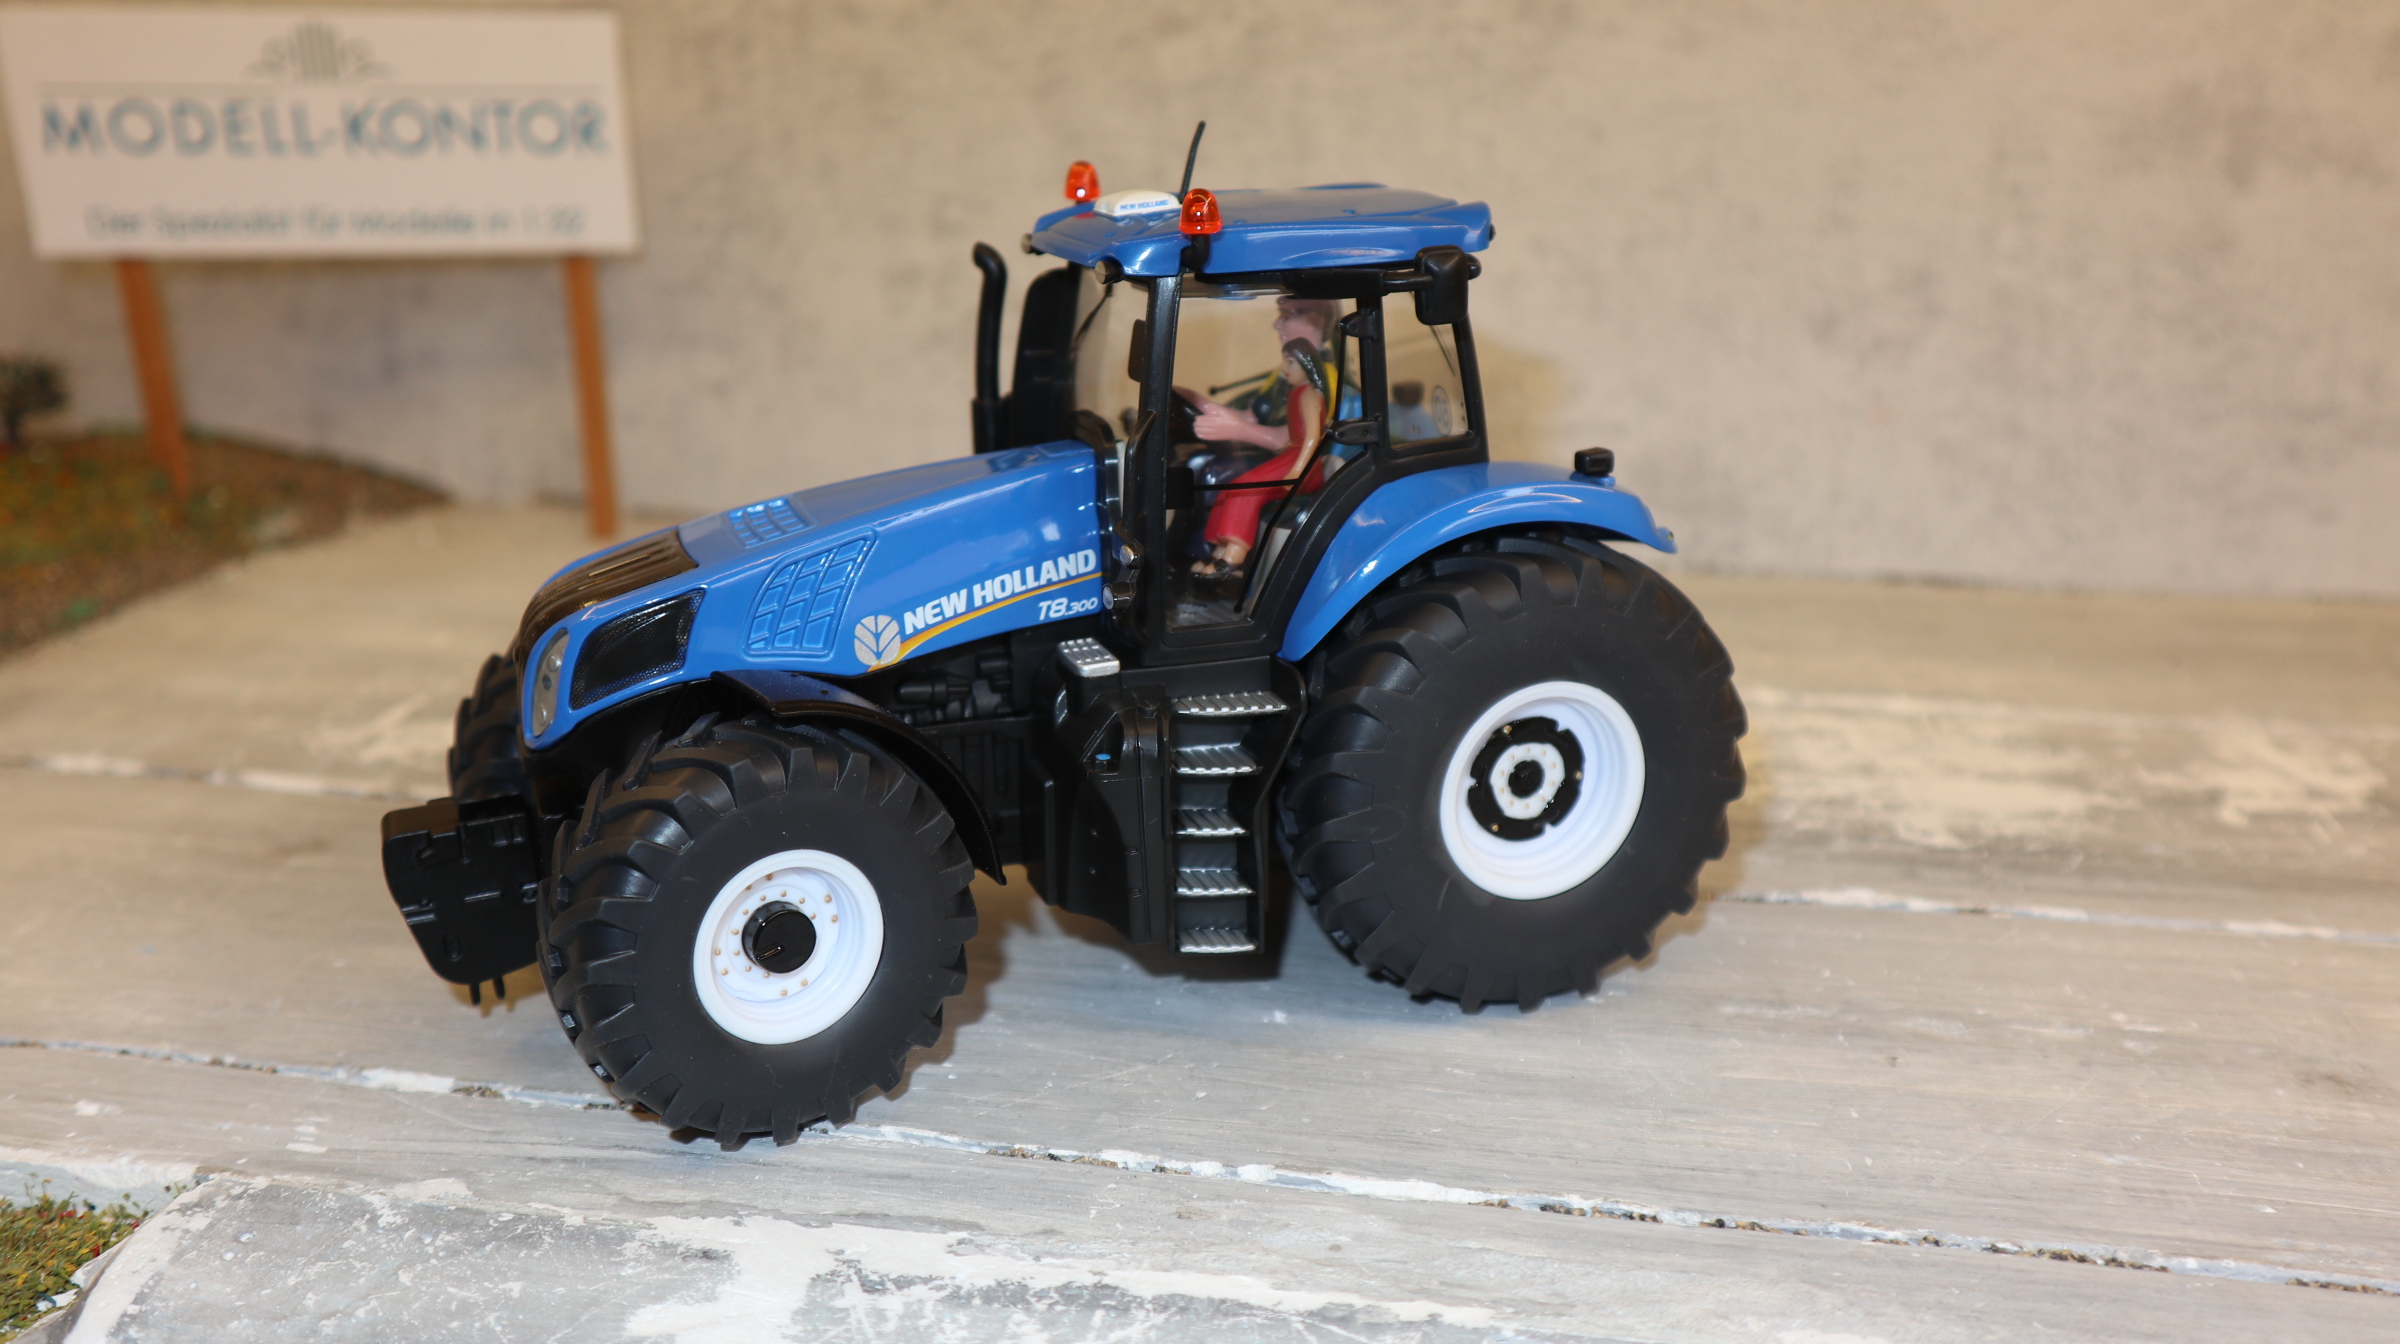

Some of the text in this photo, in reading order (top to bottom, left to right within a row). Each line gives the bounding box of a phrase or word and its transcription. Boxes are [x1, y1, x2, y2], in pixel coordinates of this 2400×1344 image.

[41, 95, 611, 157] MODELL-KONTOR
[903, 549, 1097, 635] NEW HOLLAND
[1038, 597, 1098, 621] T8.300
